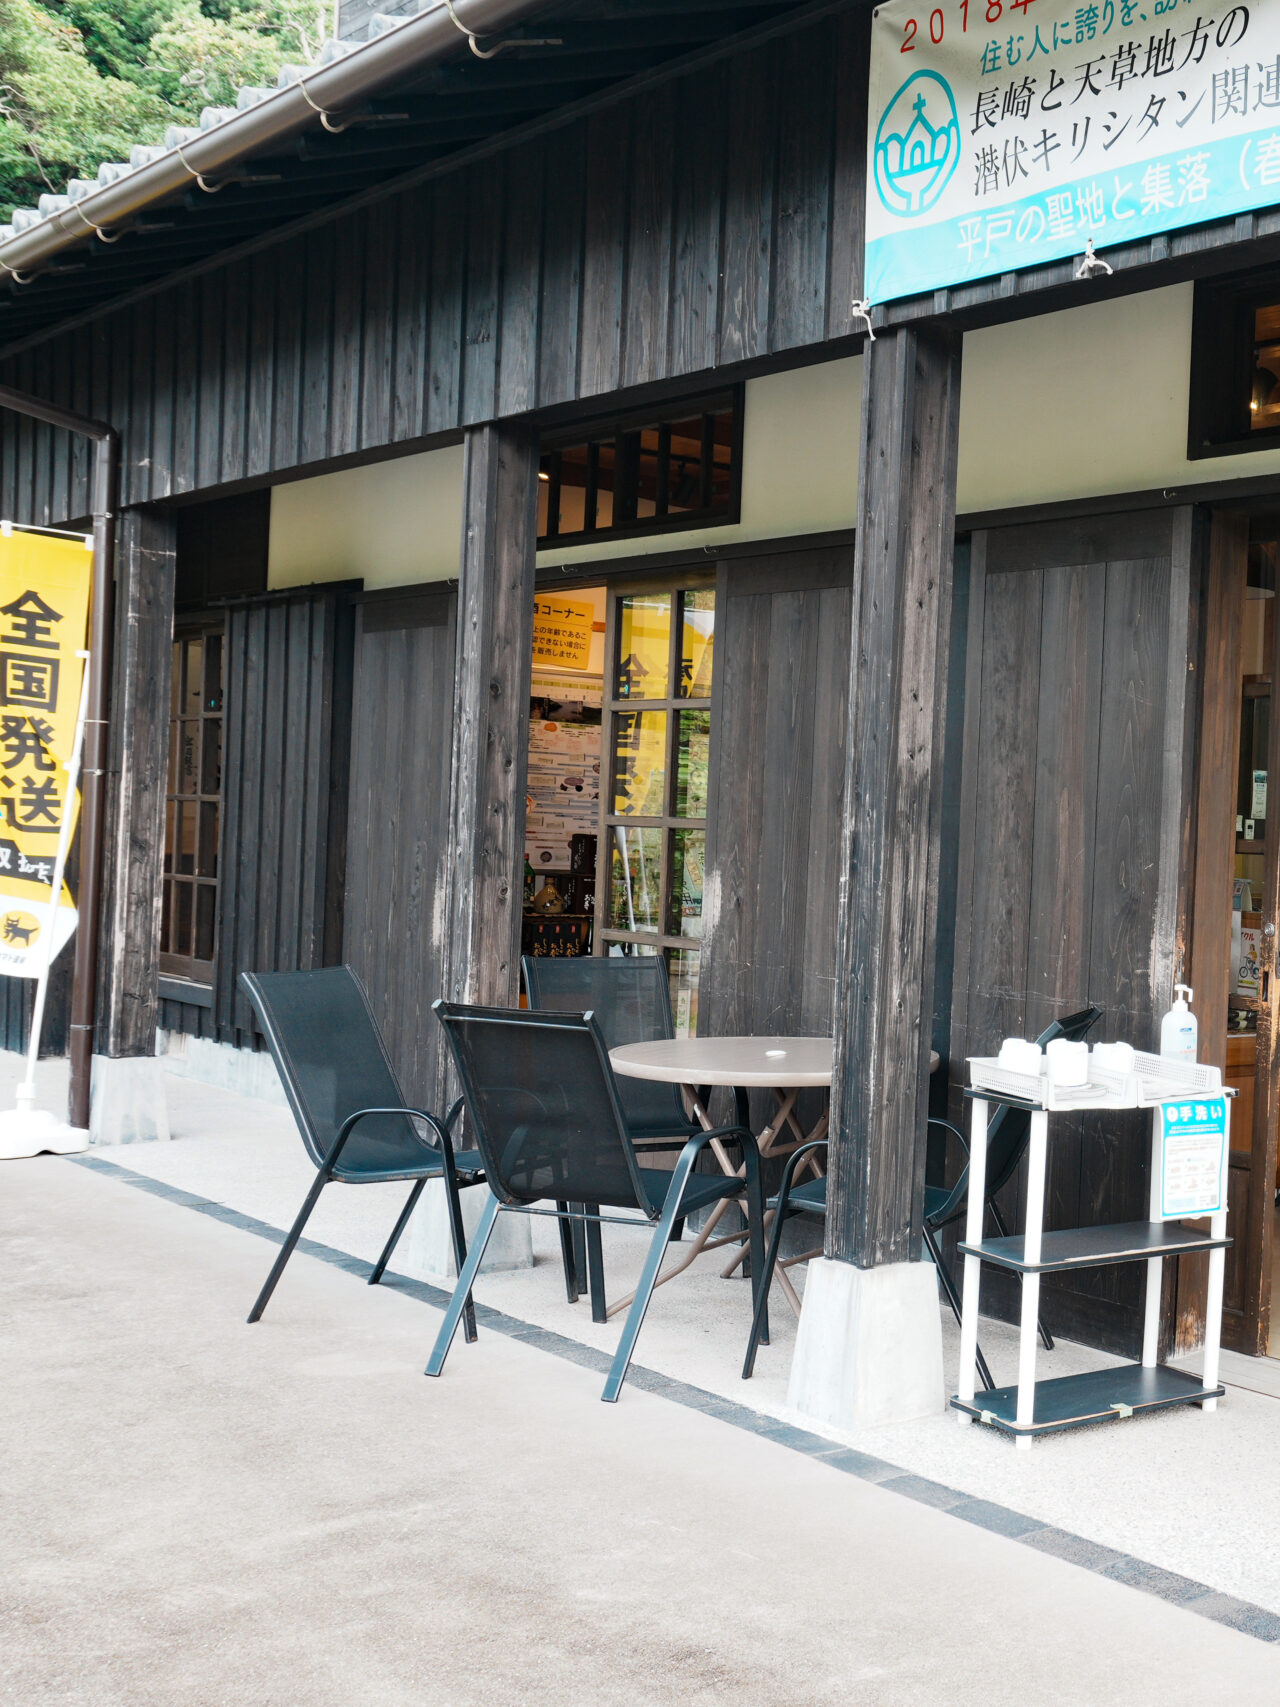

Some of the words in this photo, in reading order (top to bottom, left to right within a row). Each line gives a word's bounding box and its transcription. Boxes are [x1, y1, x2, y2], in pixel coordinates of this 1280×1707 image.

[969, 5, 1250, 136] 長崎と天草地方の
[0, 589, 63, 834] 全国発送
